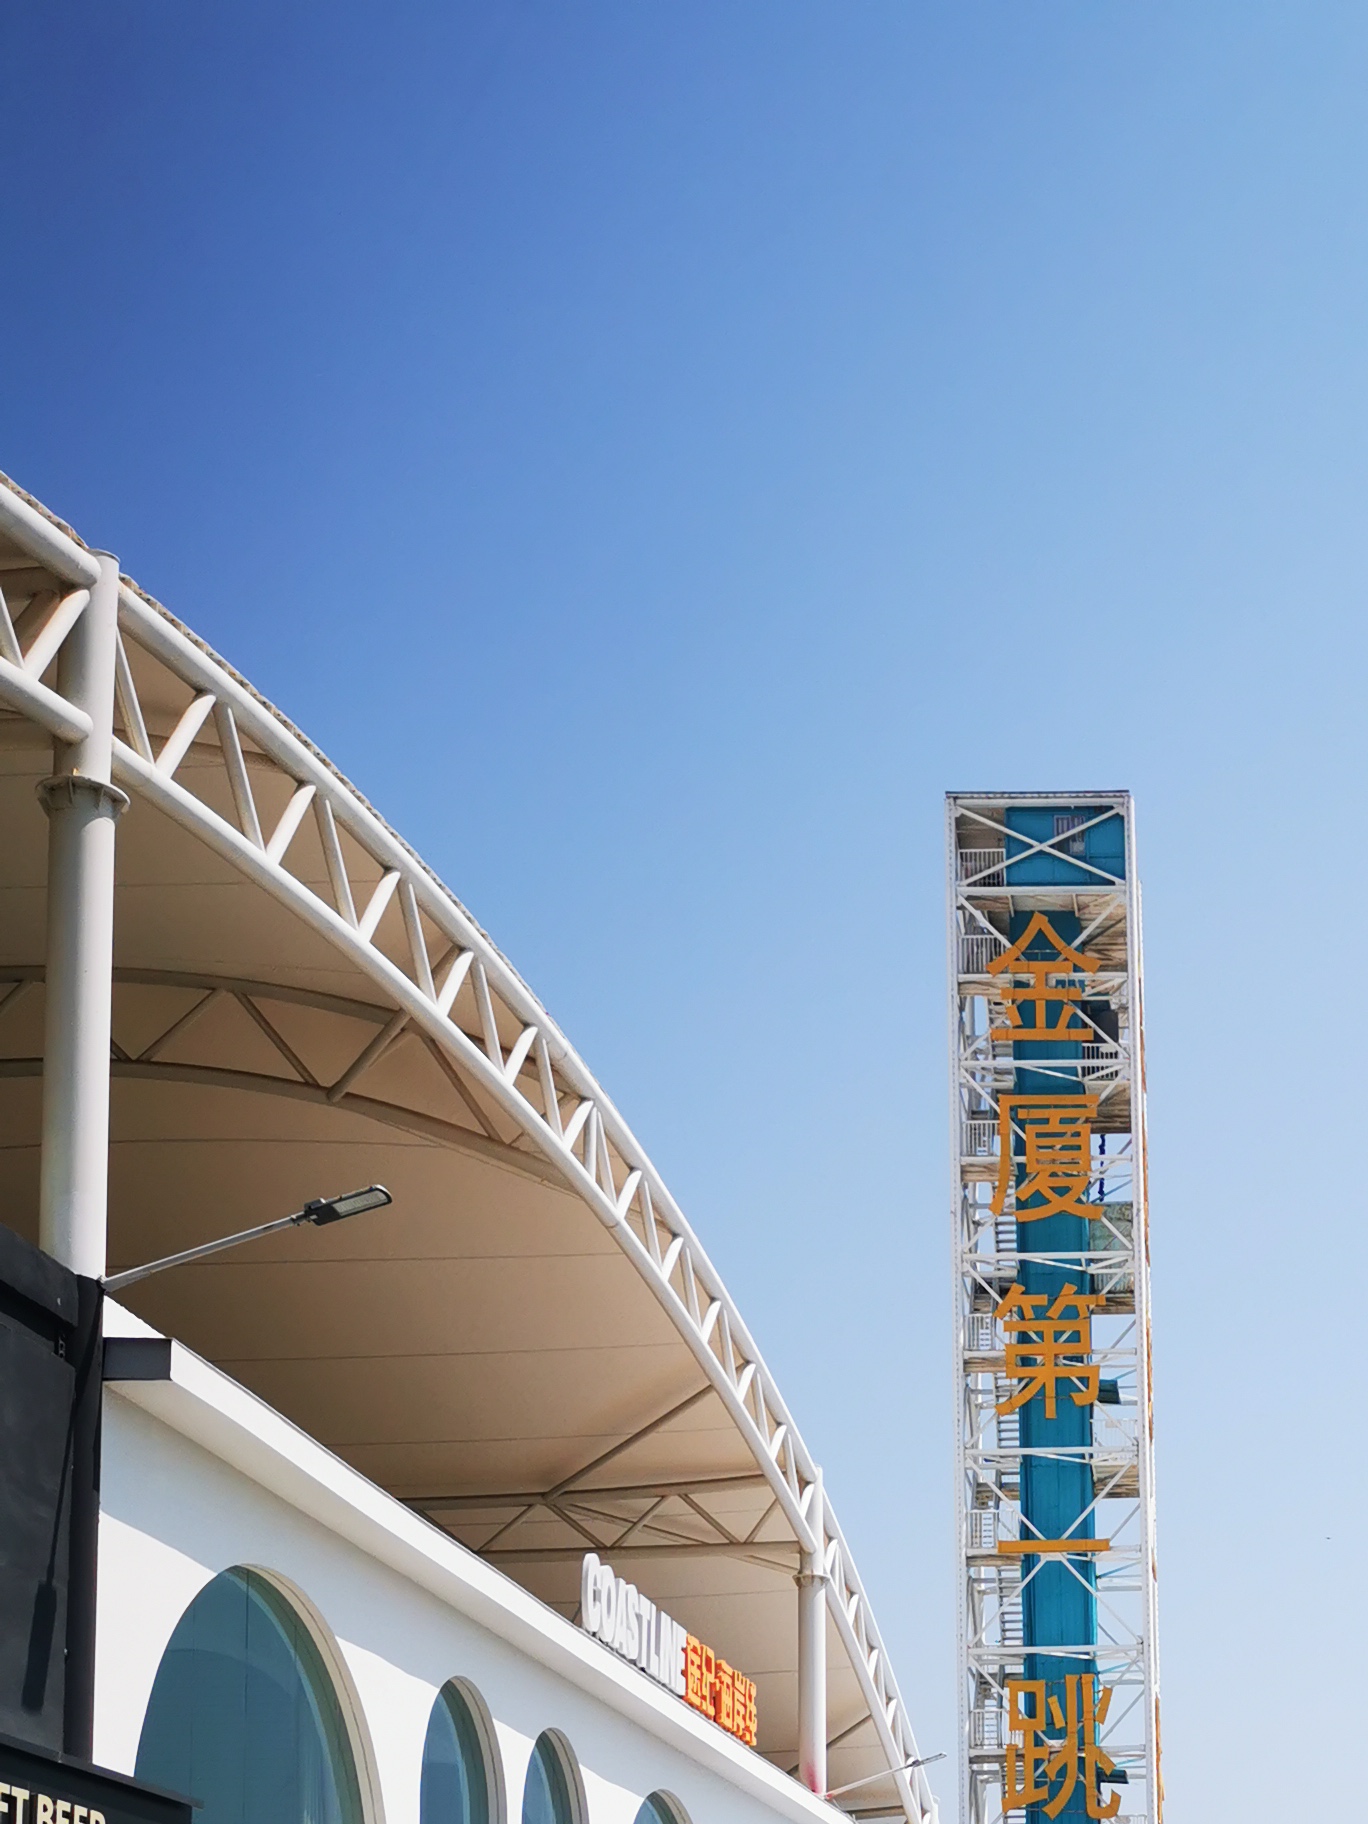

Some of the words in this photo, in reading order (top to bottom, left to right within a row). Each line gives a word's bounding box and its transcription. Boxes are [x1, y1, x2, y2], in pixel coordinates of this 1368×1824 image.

[582, 1553, 687, 1696] COASTLINE
[986, 911, 1121, 1820] 金厦第一跳
